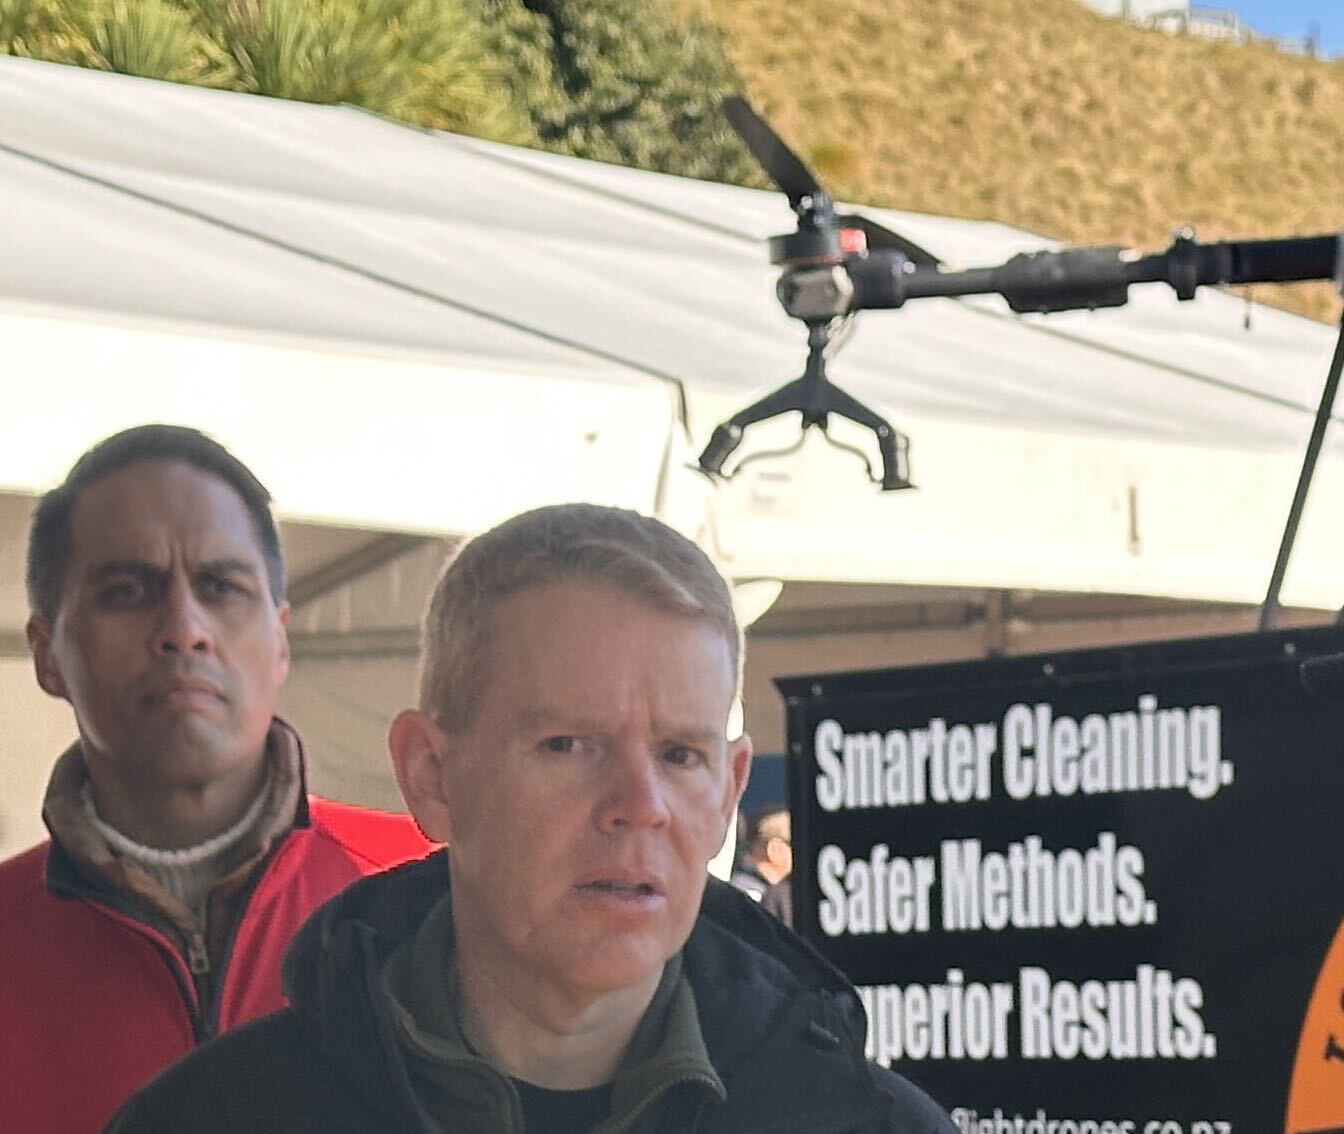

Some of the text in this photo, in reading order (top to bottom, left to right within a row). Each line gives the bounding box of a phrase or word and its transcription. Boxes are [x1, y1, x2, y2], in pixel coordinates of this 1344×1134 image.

[814, 694, 1234, 812] Smarter Cleaning.
[817, 831, 1158, 937] Safer Methods.
[1019, 964, 1217, 1060] Results.
